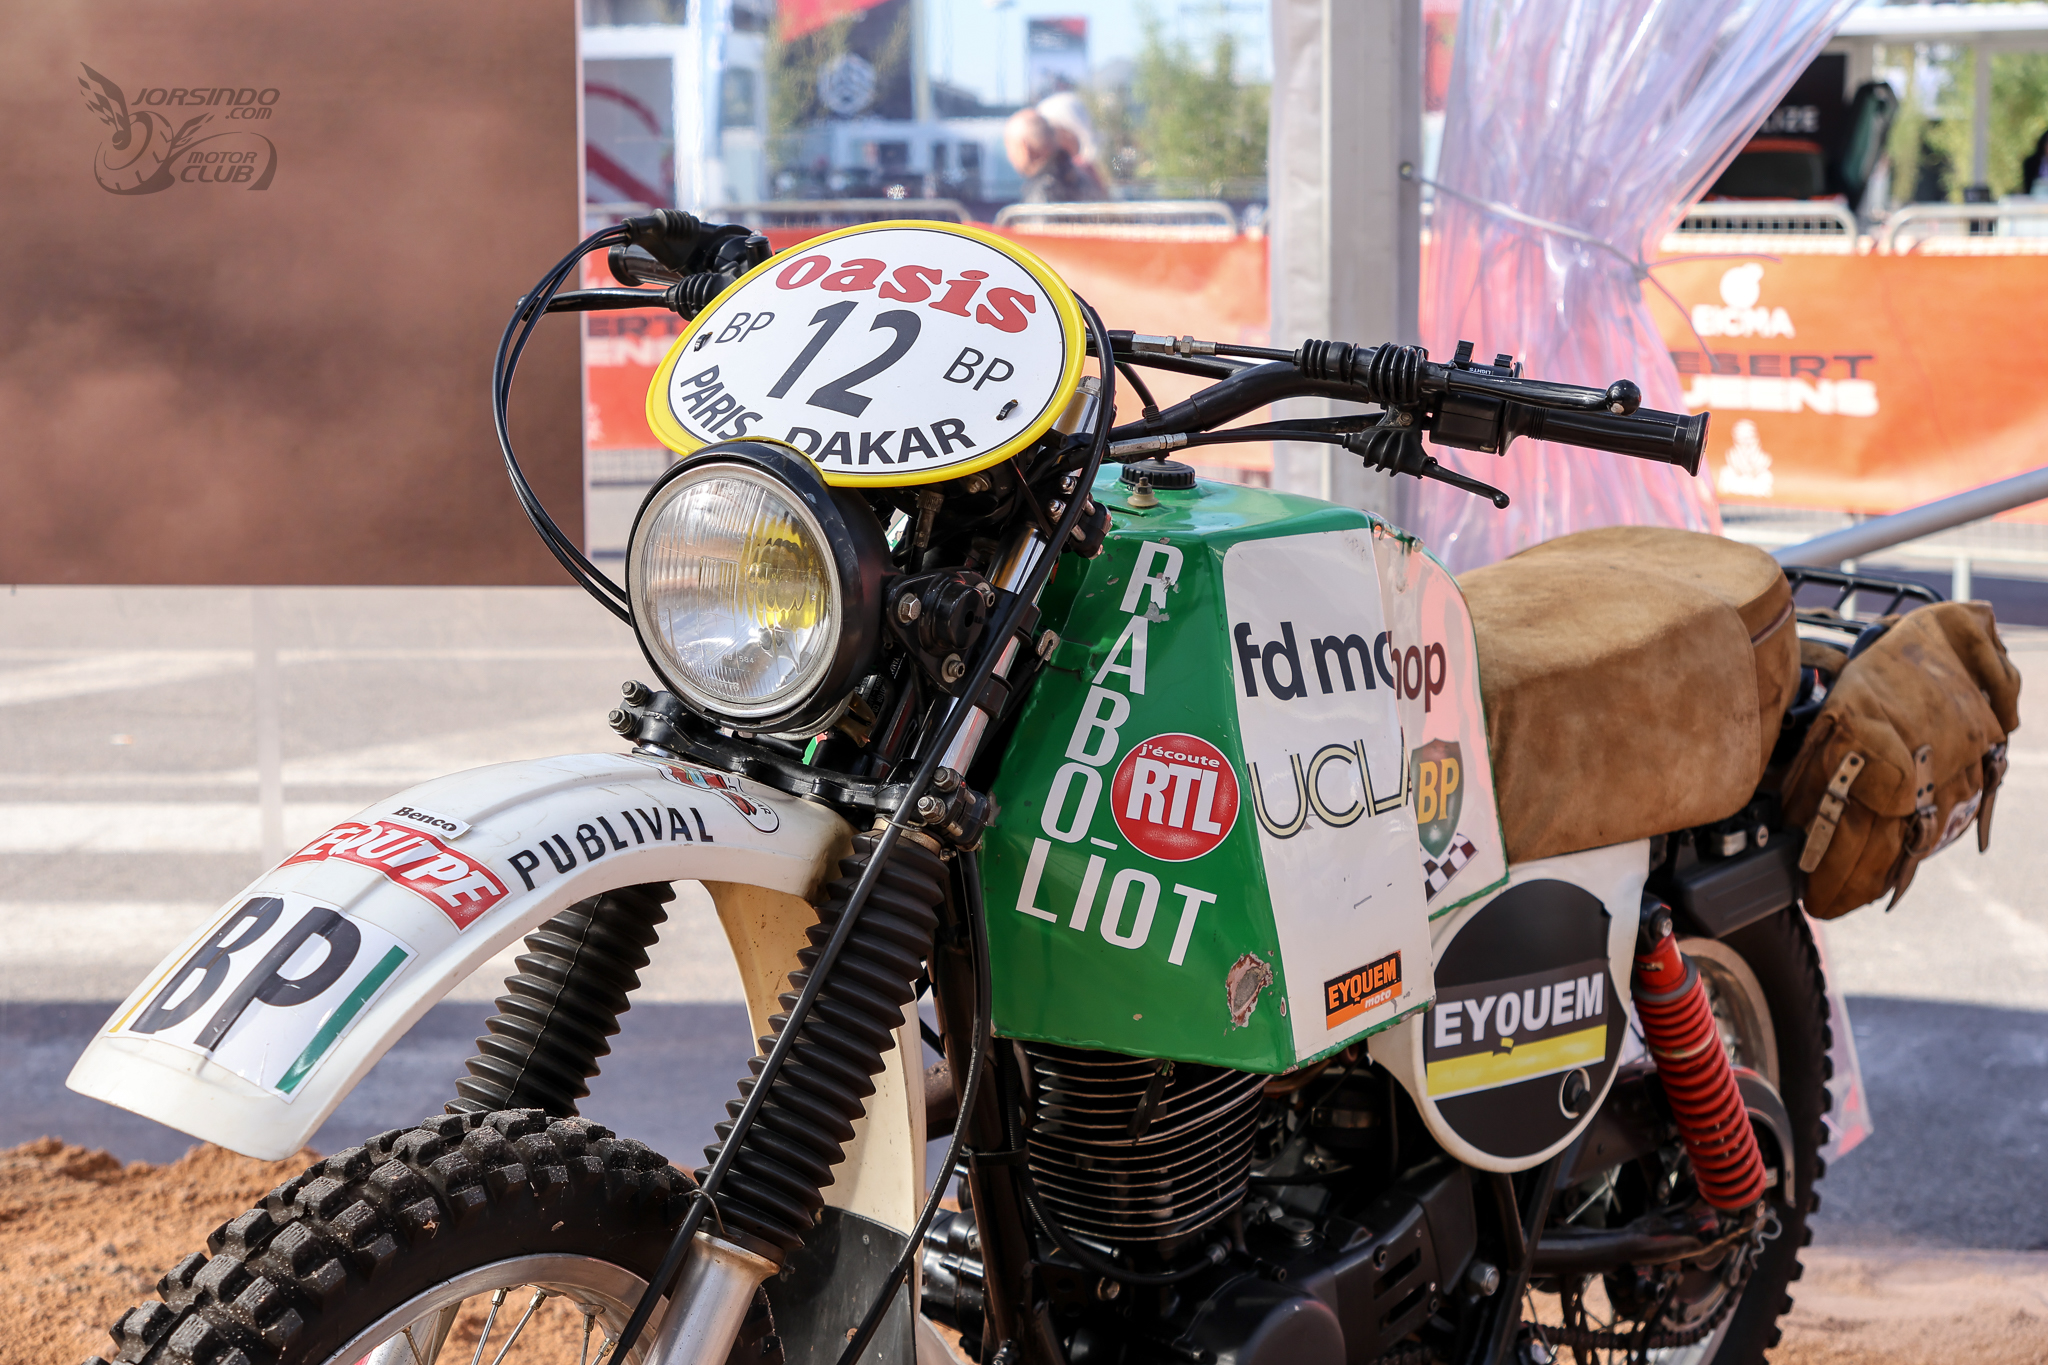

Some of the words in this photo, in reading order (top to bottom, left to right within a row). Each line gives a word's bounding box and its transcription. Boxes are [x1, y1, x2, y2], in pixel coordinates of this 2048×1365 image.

[714, 312, 776, 344] BP
[776, 254, 1037, 334] oasis
[766, 300, 922, 418] 12
[942, 346, 1015, 391] BP
[1669, 351, 1873, 379] ESERT
[680, 364, 764, 440] PARIS
[783, 418, 977, 465] DAKAR
[1234, 621, 1309, 701] fd
[1139, 744, 1220, 768] j'écoute
[1417, 757, 1460, 825] BP
[392, 806, 458, 832] Benco
[1125, 757, 1222, 836] RTL
[507, 807, 714, 892] PUBLIVAL
[128, 896, 362, 1052] BP
[1328, 957, 1397, 1010] EYQUEM
[1364, 988, 1393, 1009] moto
[1434, 971, 1605, 1049] EYQUEM
